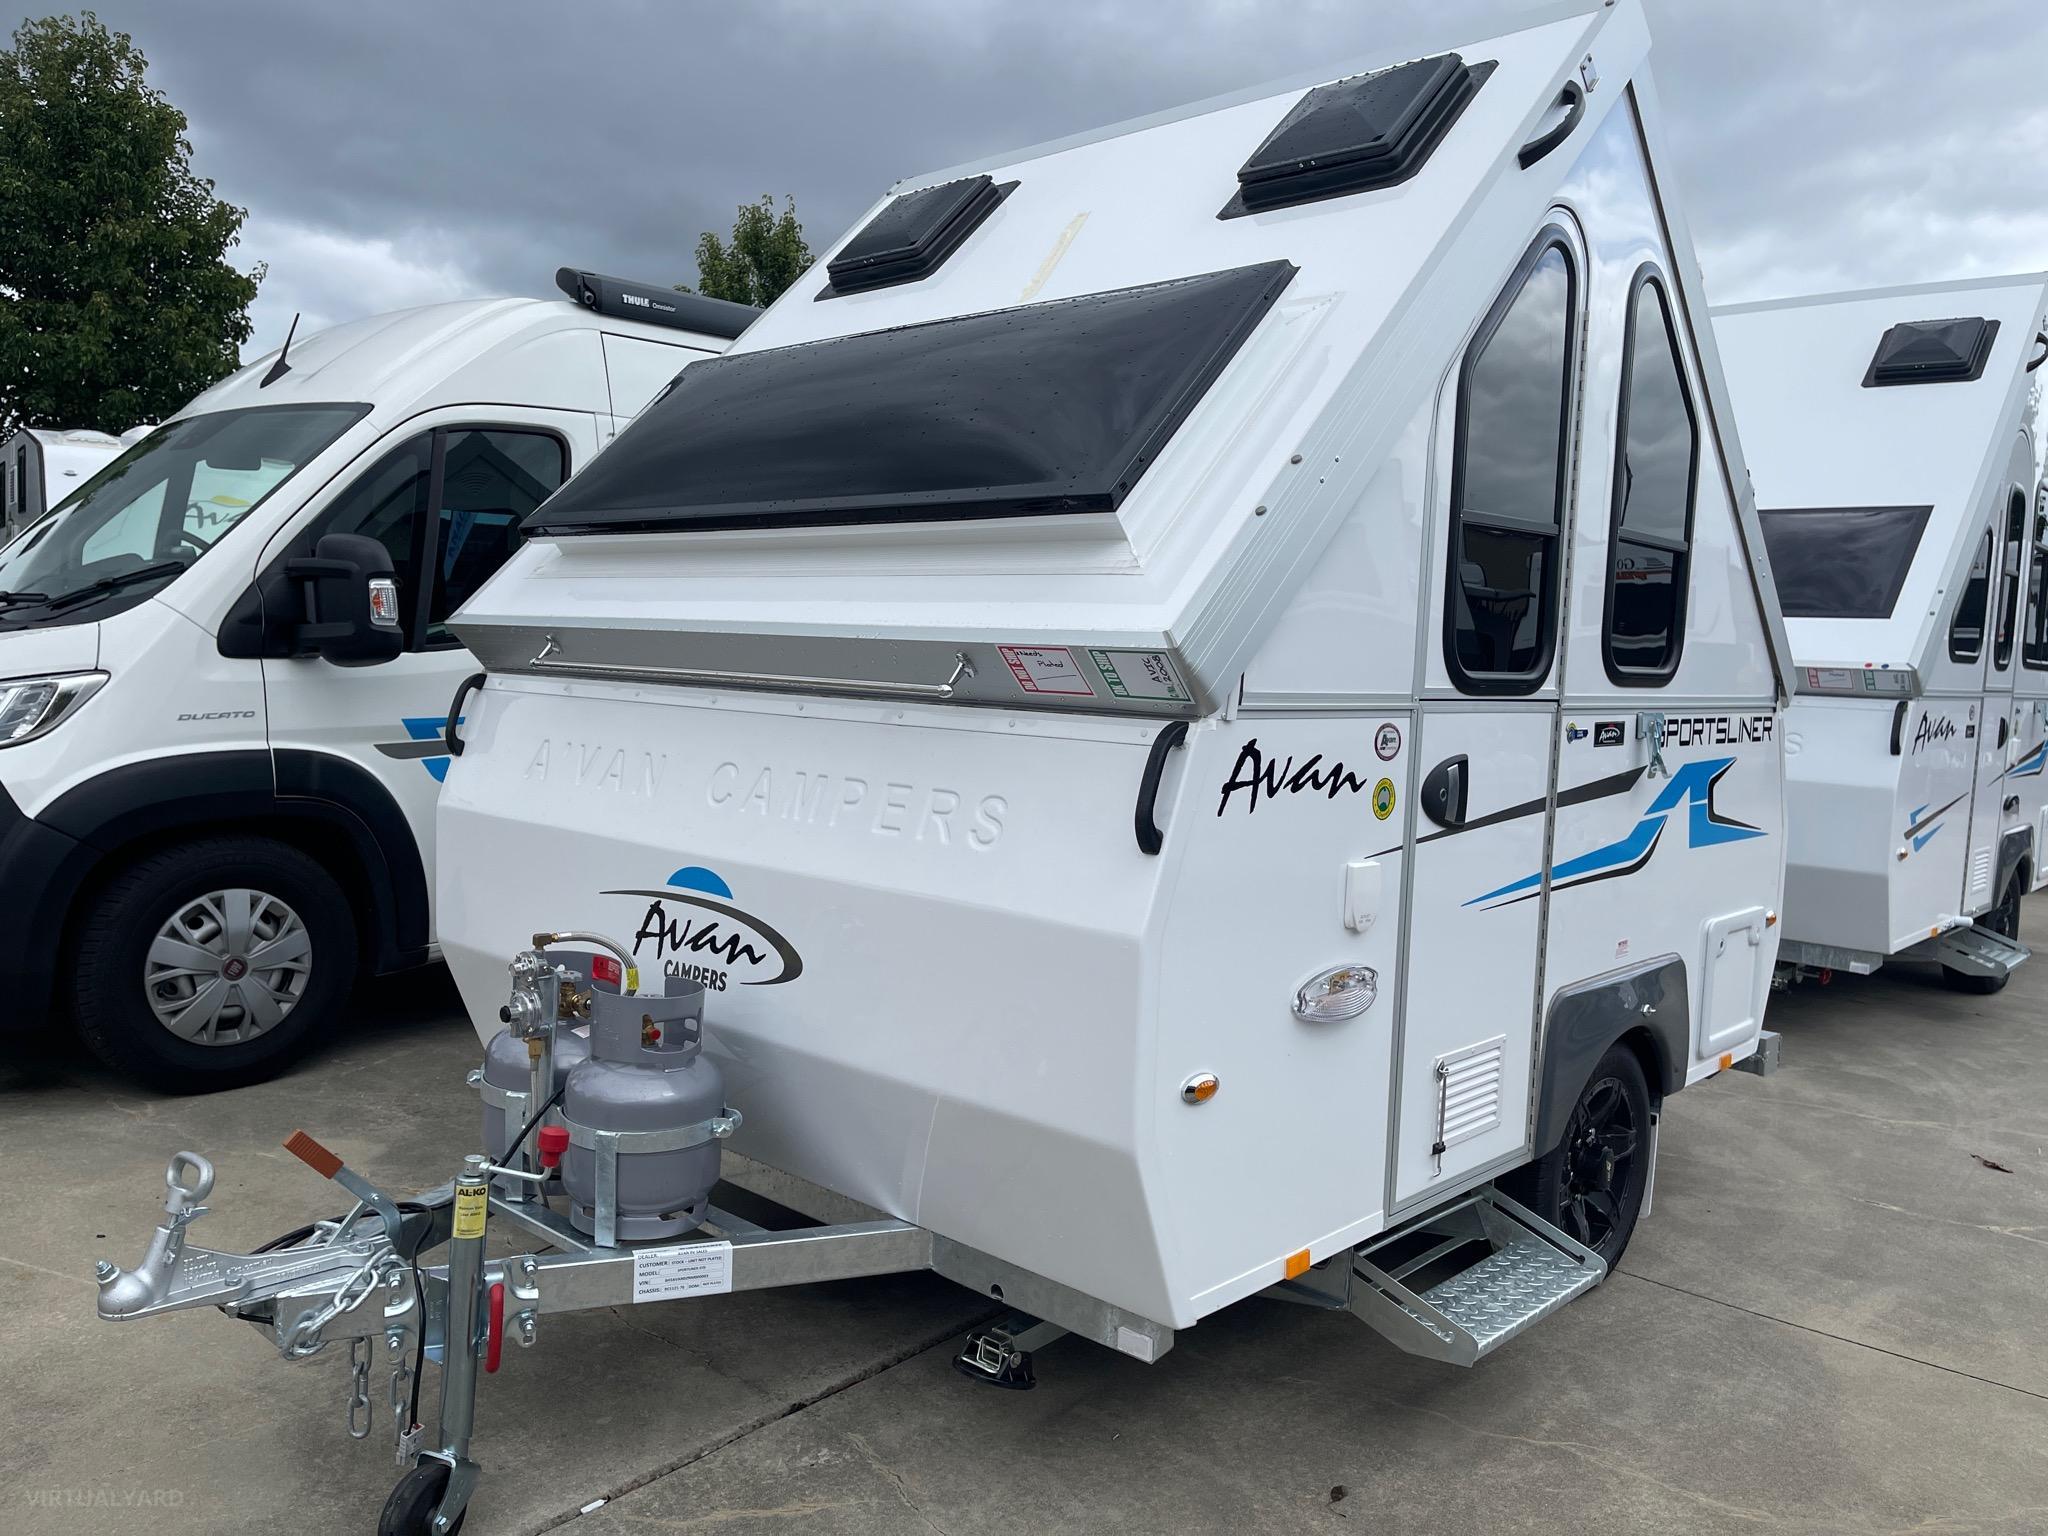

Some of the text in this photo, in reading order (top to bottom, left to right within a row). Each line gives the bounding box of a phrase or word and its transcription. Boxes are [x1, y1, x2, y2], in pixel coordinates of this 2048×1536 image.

[622, 294, 650, 308] THULE
[1001, 648, 1020, 665] SHIP
[1092, 651, 1129, 696] OK TO SHIP
[177, 710, 256, 721] DUCATO
[1912, 710, 1957, 756] Avan
[524, 738, 1010, 853] A'VAN CAMPERS
[1217, 738, 1368, 818] Avan
[633, 900, 767, 965] Avan
[664, 960, 728, 992] CAMPERS
